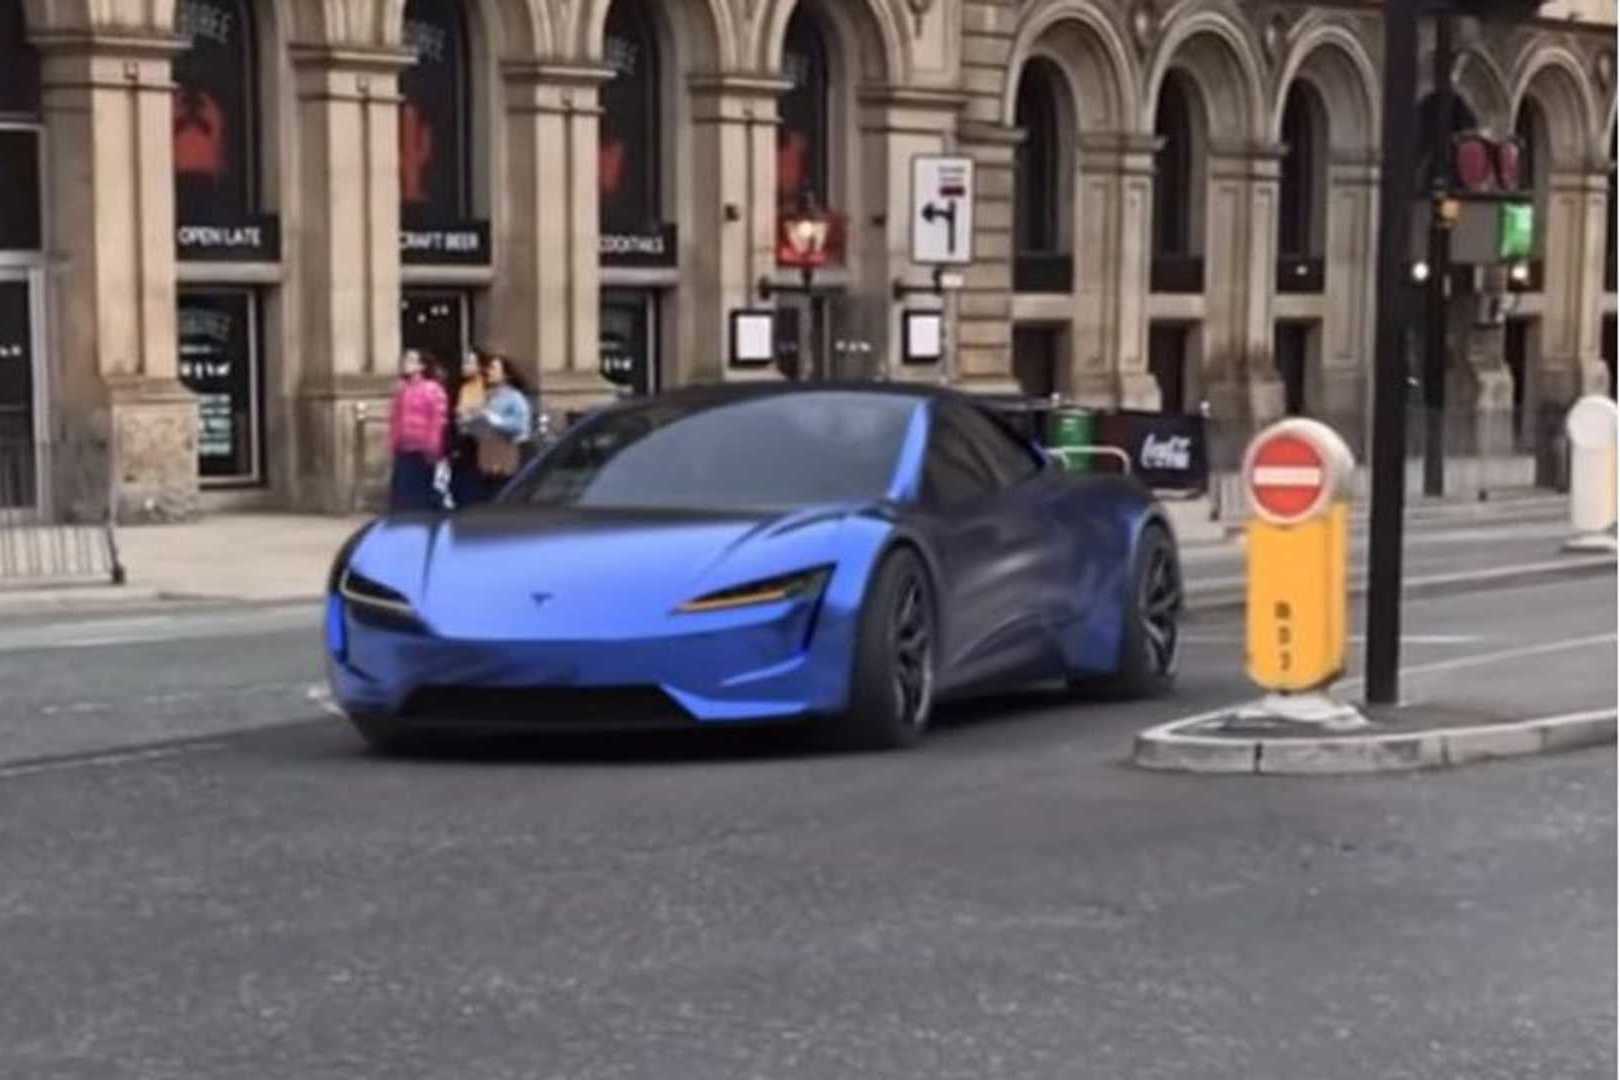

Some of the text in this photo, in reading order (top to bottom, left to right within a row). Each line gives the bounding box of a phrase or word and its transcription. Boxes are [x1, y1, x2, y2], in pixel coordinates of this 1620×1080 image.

[179, 226, 260, 247] OPEN LATE
[445, 231, 478, 251] BEER
